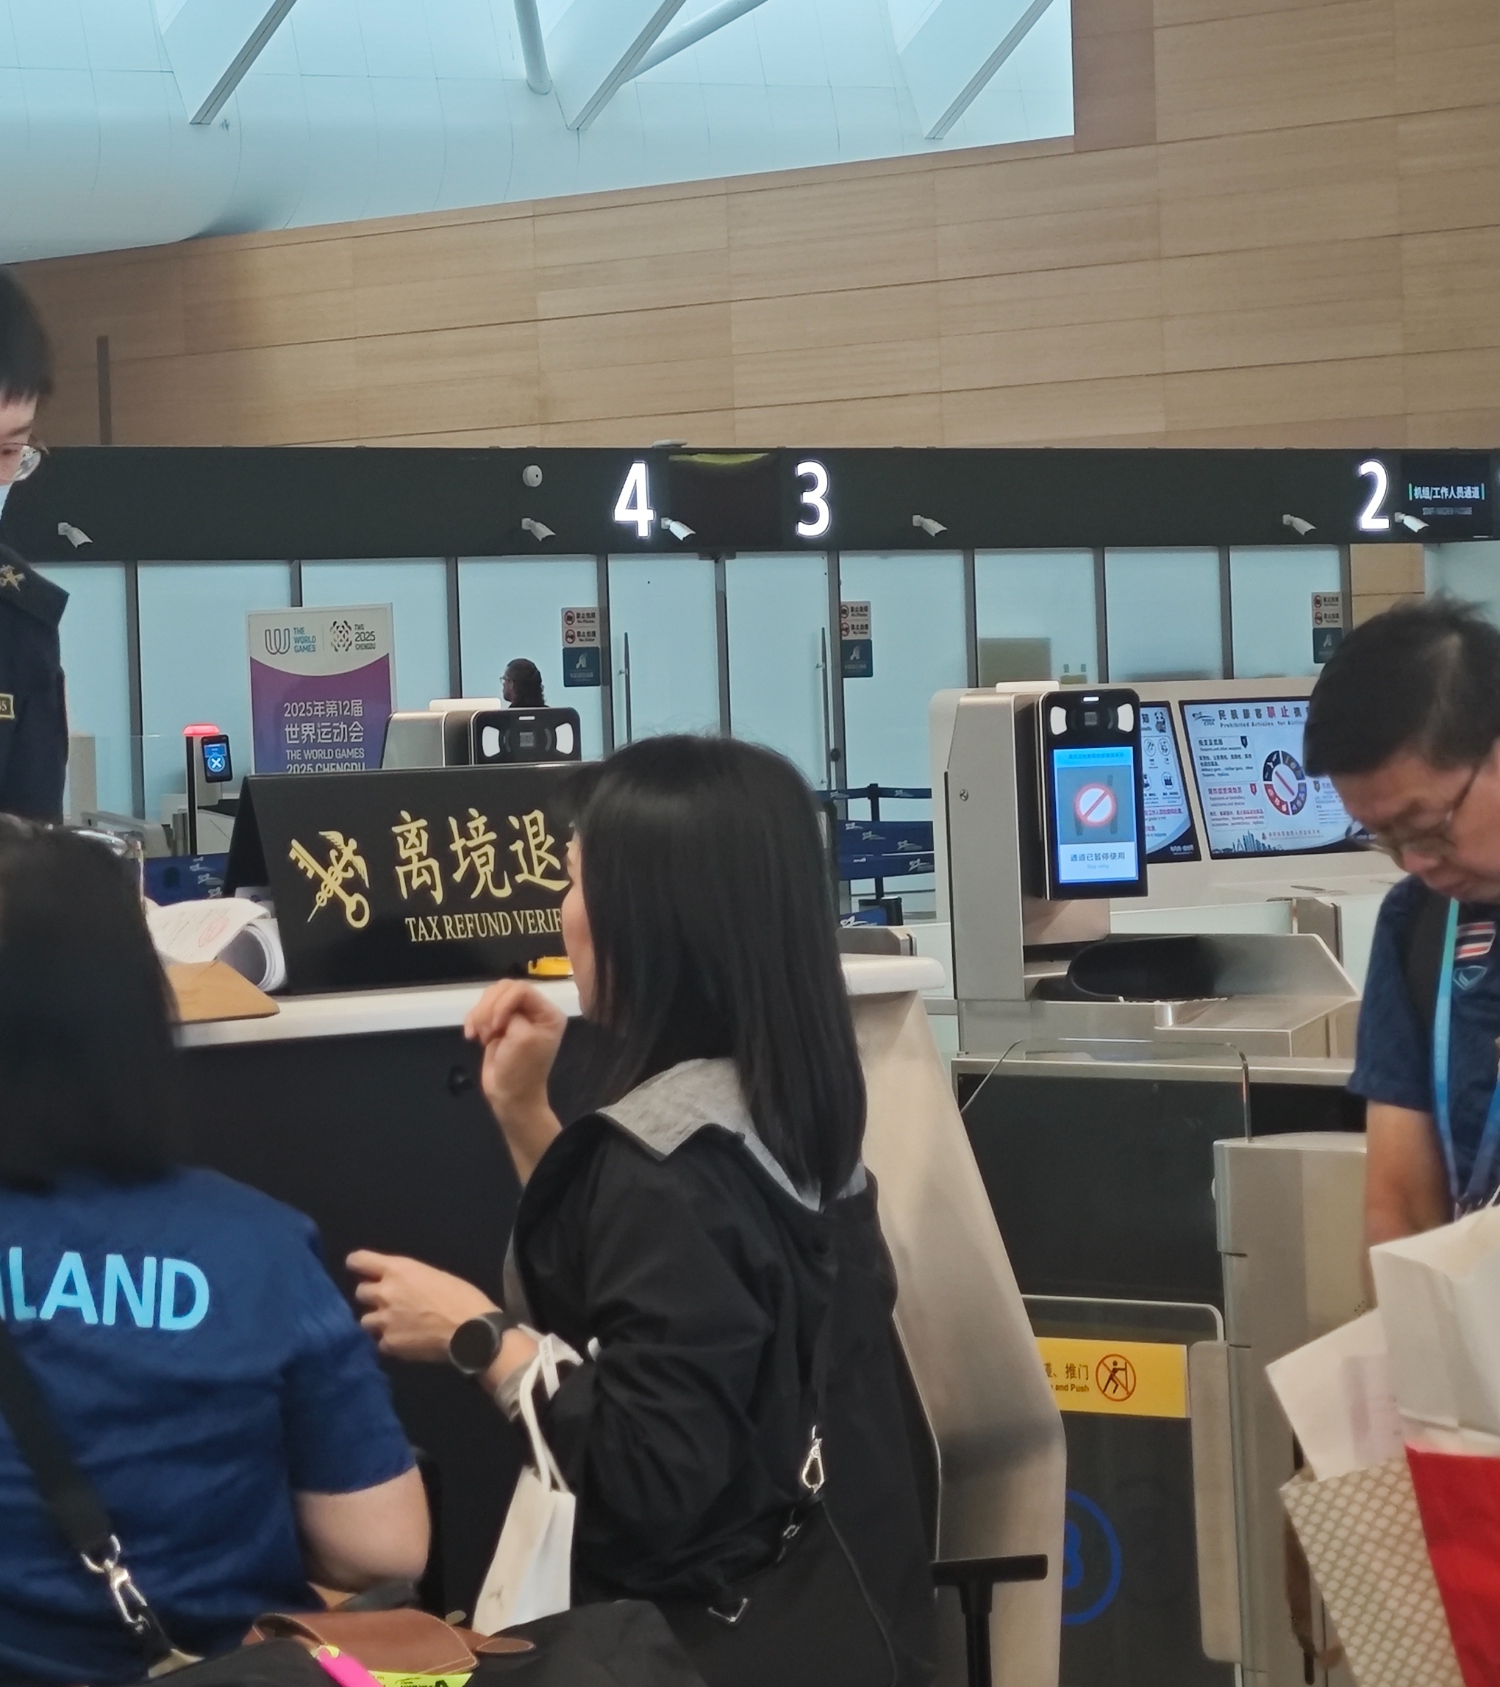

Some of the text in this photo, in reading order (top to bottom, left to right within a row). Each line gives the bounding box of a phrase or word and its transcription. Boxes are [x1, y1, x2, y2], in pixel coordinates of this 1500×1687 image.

[613, 461, 655, 538] 4
[796, 460, 831, 537] 3
[1357, 461, 1390, 530] 2
[1414, 486, 1480, 500] 机组/工作人员通道
[293, 627, 305, 636] THE
[293, 635, 316, 644] WORLD
[354, 630, 376, 642] 2025
[294, 644, 316, 653] GAMES
[283, 699, 363, 718] 2025年第12届
[284, 721, 364, 744] 世界运动会
[286, 747, 364, 760] THE WORLD GAMES
[392, 808, 570, 905] 离境退
[405, 914, 441, 942] TAX
[445, 910, 512, 940] REFUND
[1055, 1383, 1069, 1392] and
[1070, 1384, 1090, 1392] Push
